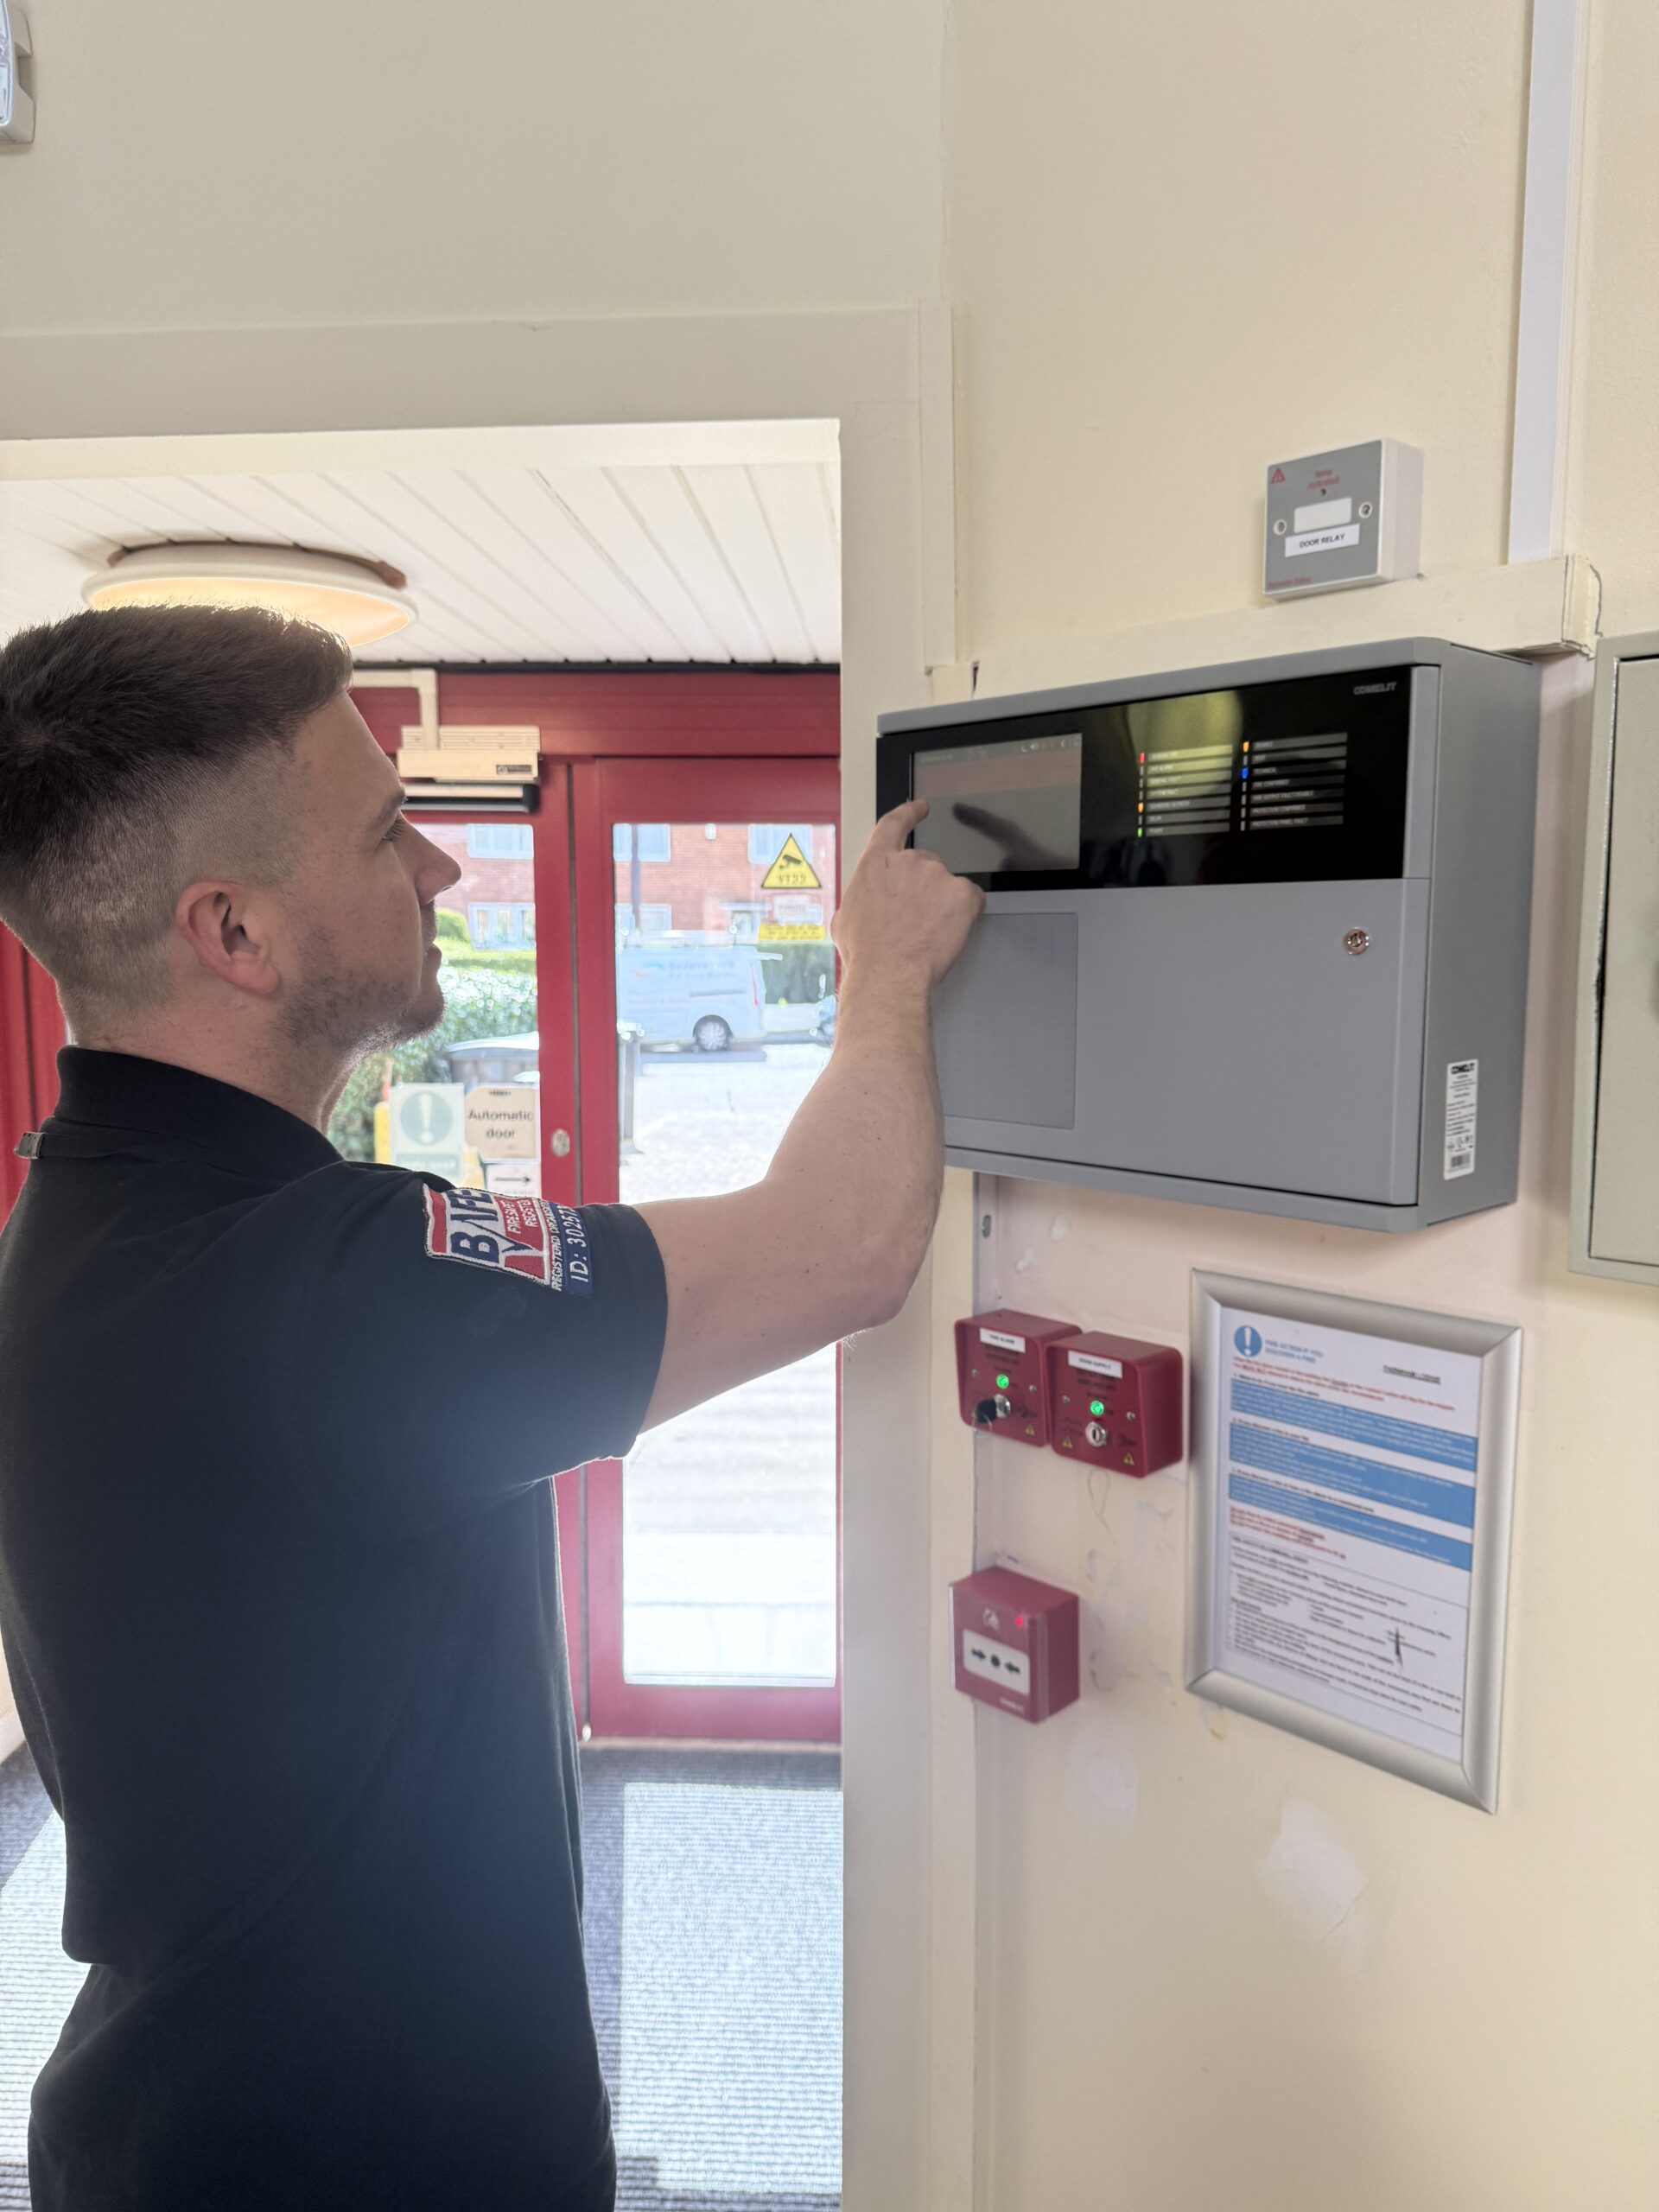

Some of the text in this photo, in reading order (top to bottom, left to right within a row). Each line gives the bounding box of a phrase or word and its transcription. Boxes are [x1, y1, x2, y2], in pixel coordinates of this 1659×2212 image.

[1299, 533, 1345, 549] DOOR RELAY
[1353, 682, 1397, 695] COMELIT
[468, 1109, 534, 1122] Automatic
[486, 1127, 515, 1139] door
[447, 1189, 529, 1264] BAFE
[551, 1235, 563, 1292] REGISTERED
[569, 1253, 588, 1283] ID:
